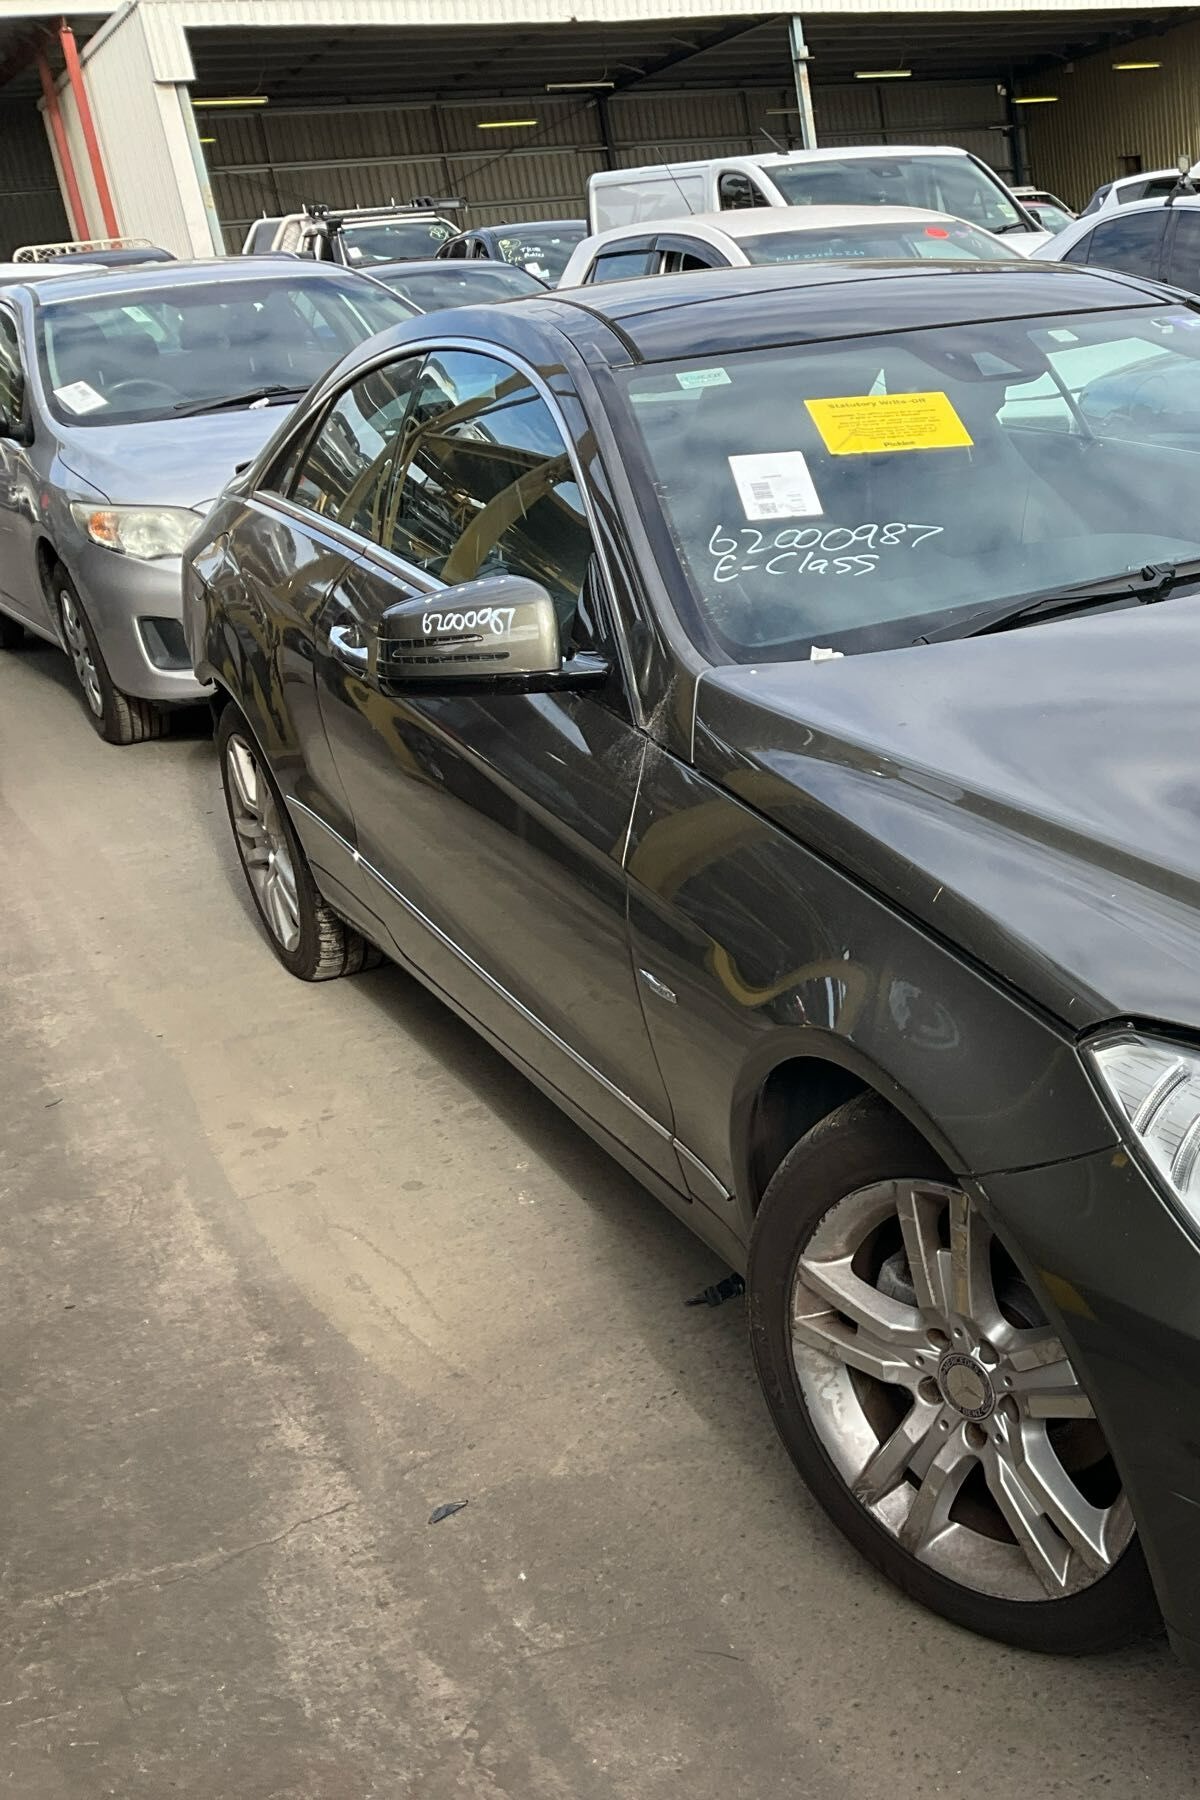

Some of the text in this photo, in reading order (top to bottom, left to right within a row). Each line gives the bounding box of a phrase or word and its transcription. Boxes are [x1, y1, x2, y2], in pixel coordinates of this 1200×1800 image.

[828, 399, 877, 410] Statutory
[708, 522, 945, 557] 62000987
[713, 551, 880, 583] E-Class
[421, 606, 517, 636] 62000987
